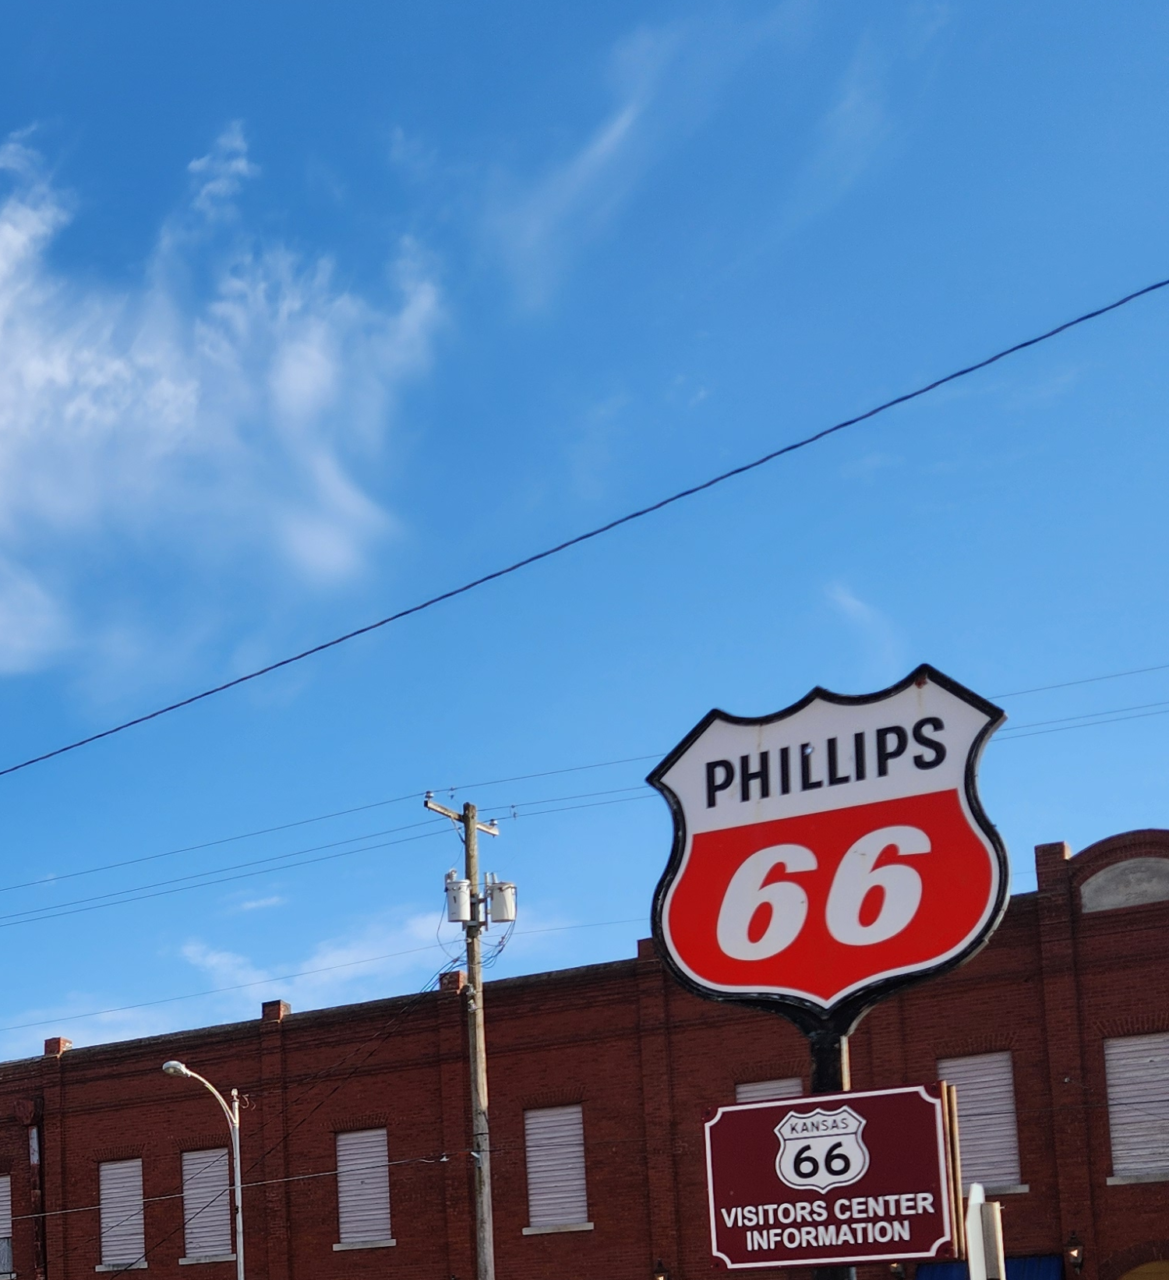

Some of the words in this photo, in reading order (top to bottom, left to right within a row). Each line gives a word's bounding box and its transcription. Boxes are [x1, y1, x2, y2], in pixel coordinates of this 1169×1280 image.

[705, 716, 947, 809] PHILLIPS
[716, 824, 932, 962] 66
[790, 1118, 849, 1134] KANSAS
[793, 1142, 851, 1179] 66
[721, 1200, 828, 1228] VISITORS
[834, 1192, 935, 1220] CENTER
[746, 1220, 911, 1251] INFORMATION
